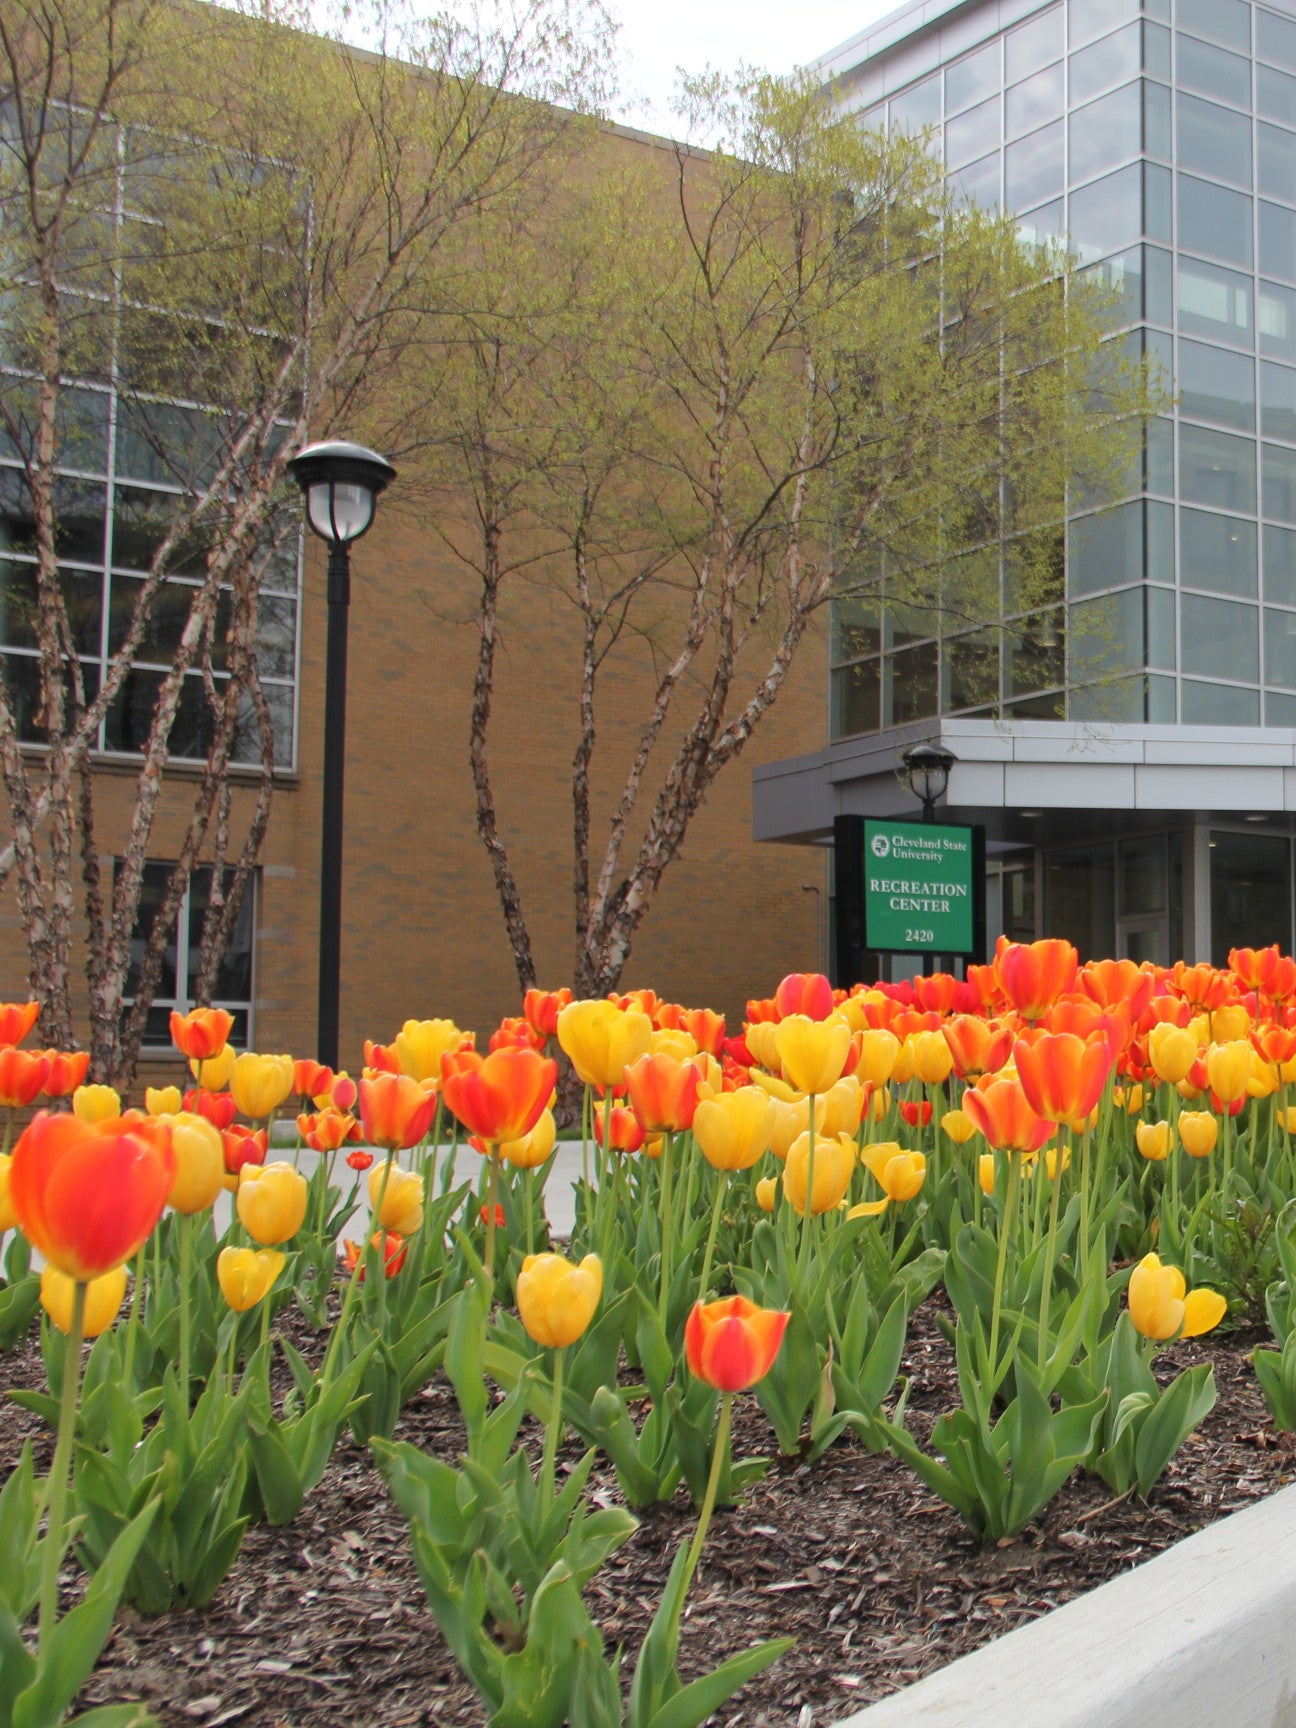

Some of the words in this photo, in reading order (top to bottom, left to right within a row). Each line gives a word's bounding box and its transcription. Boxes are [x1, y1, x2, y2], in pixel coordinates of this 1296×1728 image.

[892, 835, 941, 849] Cleveland
[943, 840, 967, 851] State
[892, 848, 943, 864] University
[870, 879, 967, 897] RECREATION
[889, 897, 950, 913] CENTER
[905, 929, 934, 942] 2420
